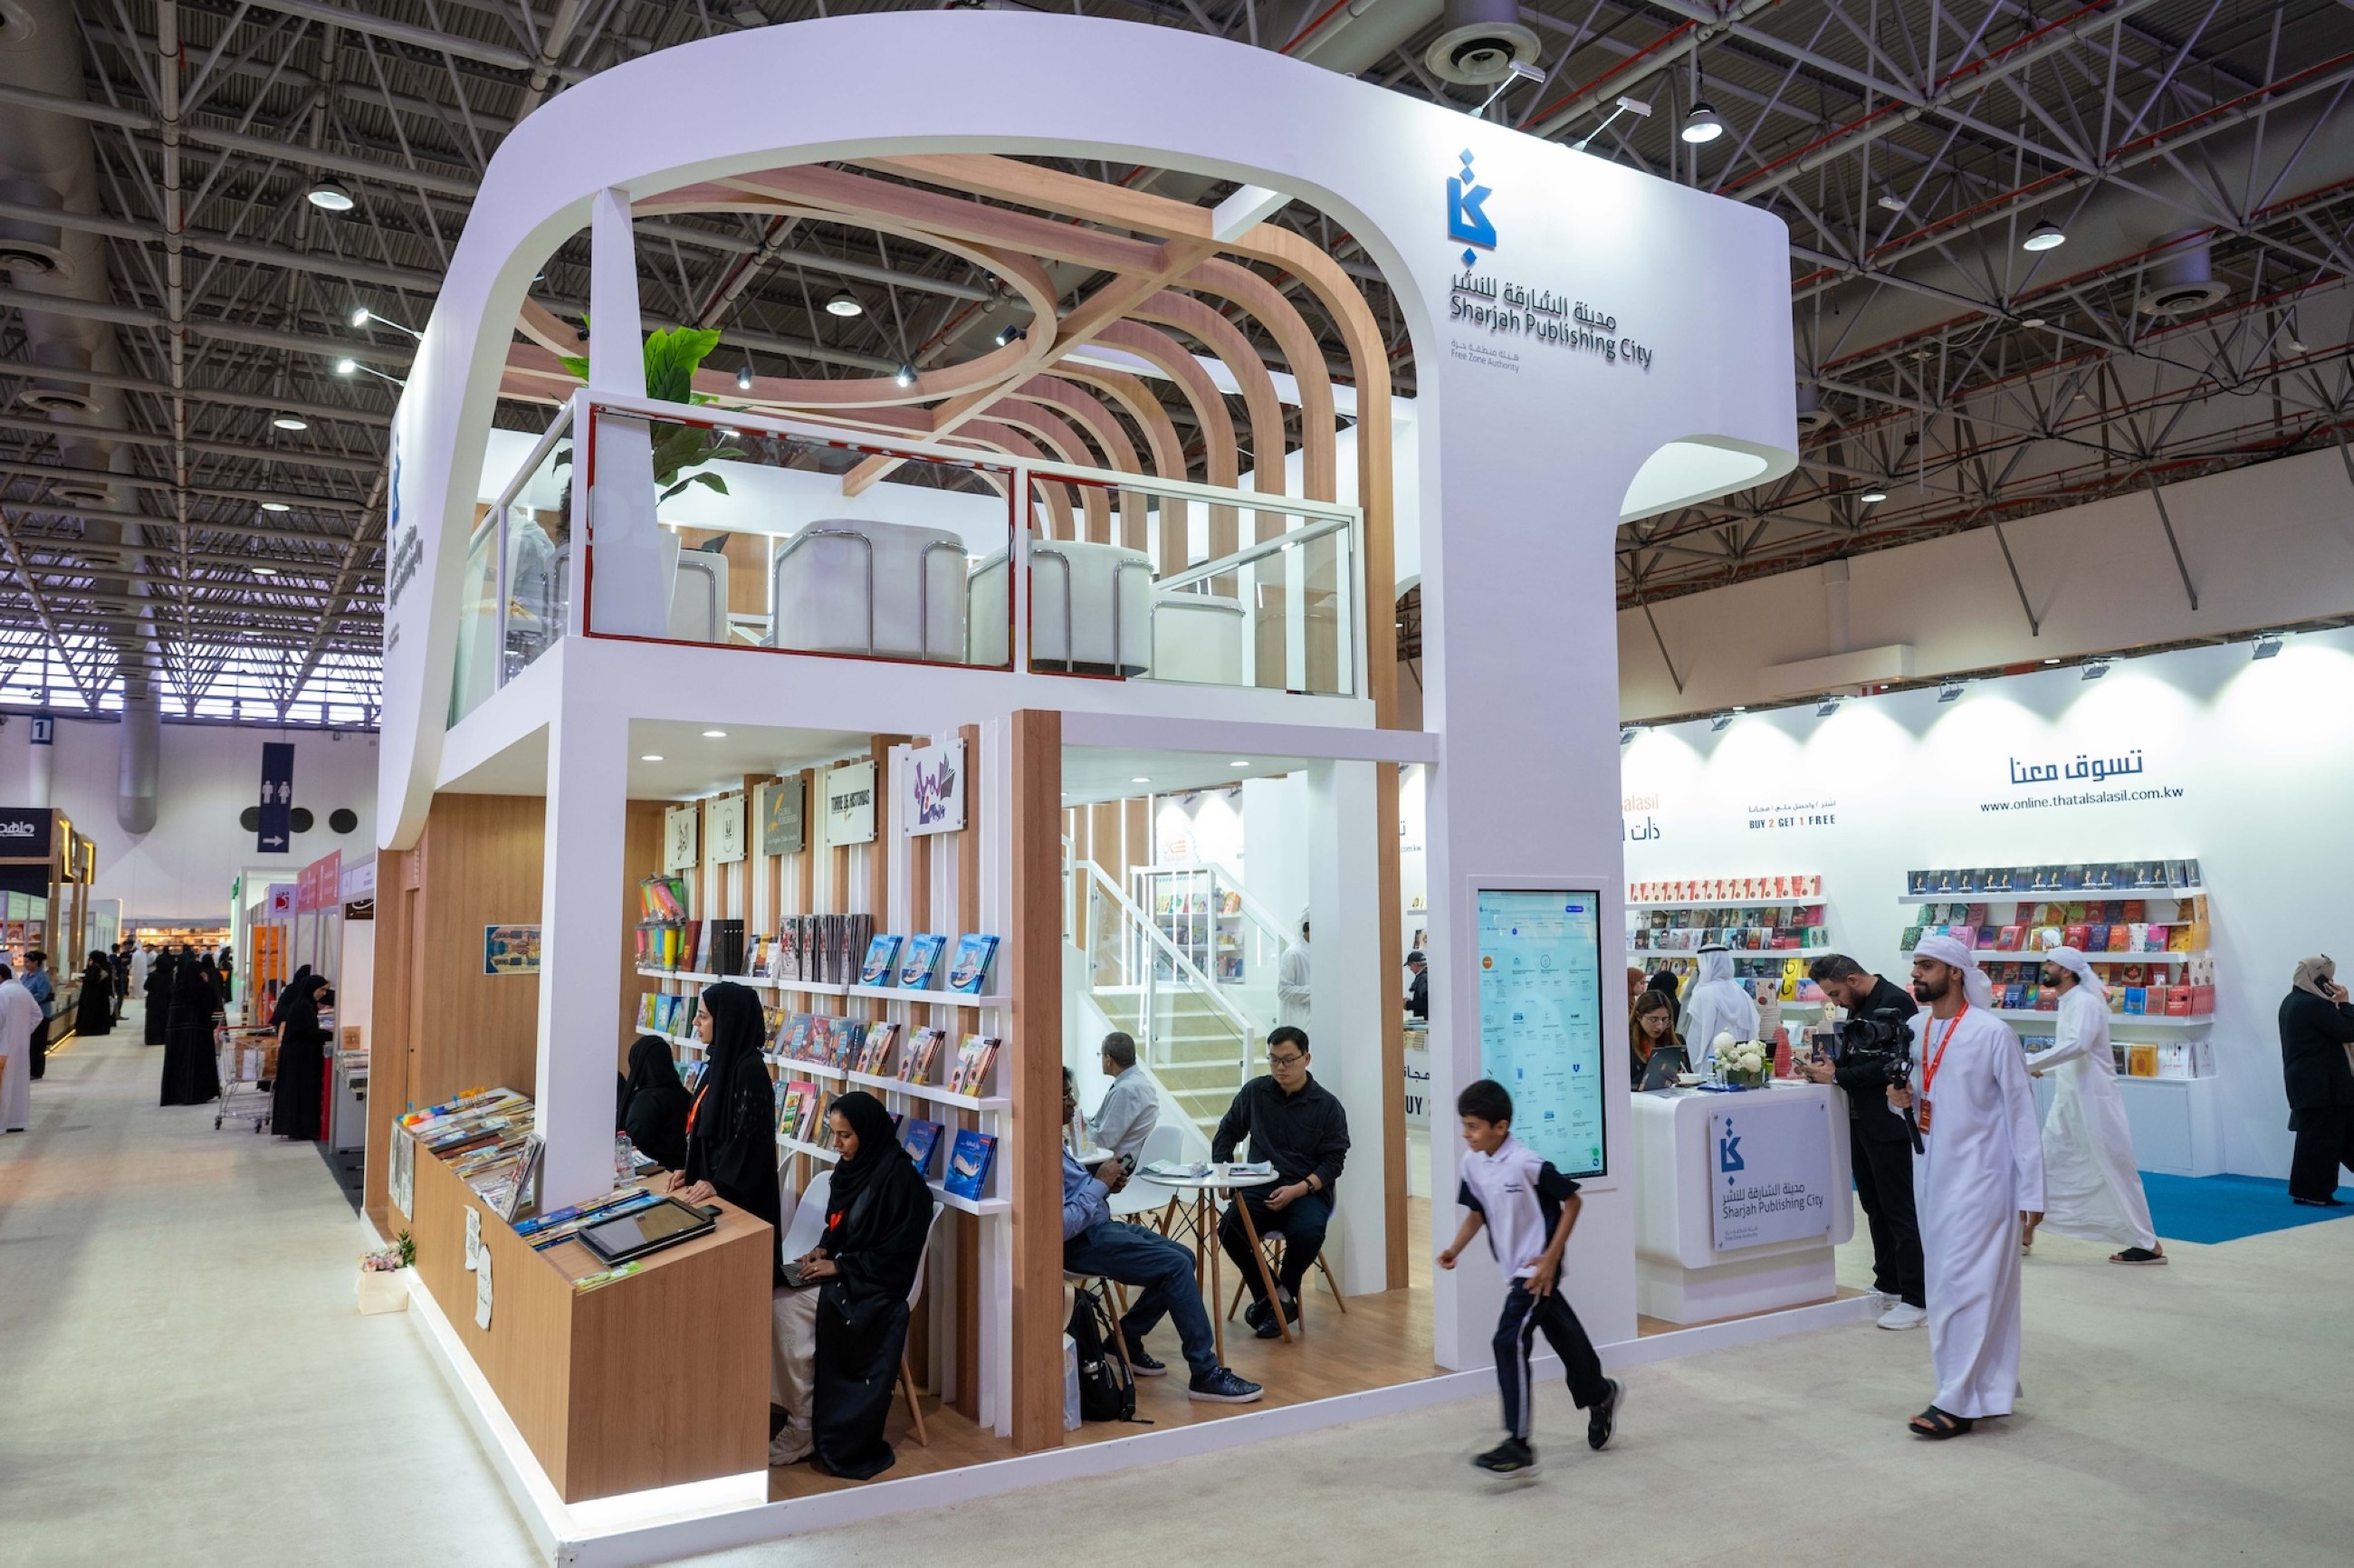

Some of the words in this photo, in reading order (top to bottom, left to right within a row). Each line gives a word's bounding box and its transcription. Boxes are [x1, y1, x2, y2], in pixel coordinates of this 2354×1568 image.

[1450, 270, 1497, 299] للنشر
[1503, 282, 1567, 317] الشارقة
[1574, 301, 1616, 330] مدينة
[1450, 295, 1520, 330] Sharjah
[1526, 313, 1616, 360] Publishing
[1621, 339, 1652, 369] City
[1450, 349, 1467, 360] Free
[1469, 352, 1486, 364] Zone
[1488, 358, 1519, 374] Authority
[34, 722, 44, 738] 1
[2010, 757, 2058, 784] معنا
[2065, 749, 2143, 782] تسوق
[1622, 792, 1659, 813] alasil
[1980, 786, 2185, 813] www.online.thatalsalasil.com.kw
[1632, 816, 1660, 840] ذات
[1749, 819, 1766, 829] BUY
[1768, 818, 1775, 827] 2
[1778, 817, 1794, 827] GET
[1800, 817, 1804, 826] 1
[1809, 815, 1835, 825] FREE
[1405, 1095, 1422, 1115] UY
[1723, 1189, 1746, 1206] للنشر
[1747, 1183, 1780, 1200] الشارقة
[1783, 1182, 1805, 1196] مدينة
[1723, 1203, 1756, 1219] Sharjah
[1759, 1198, 1805, 1213] Publishing
[1806, 1194, 1824, 1209] City
